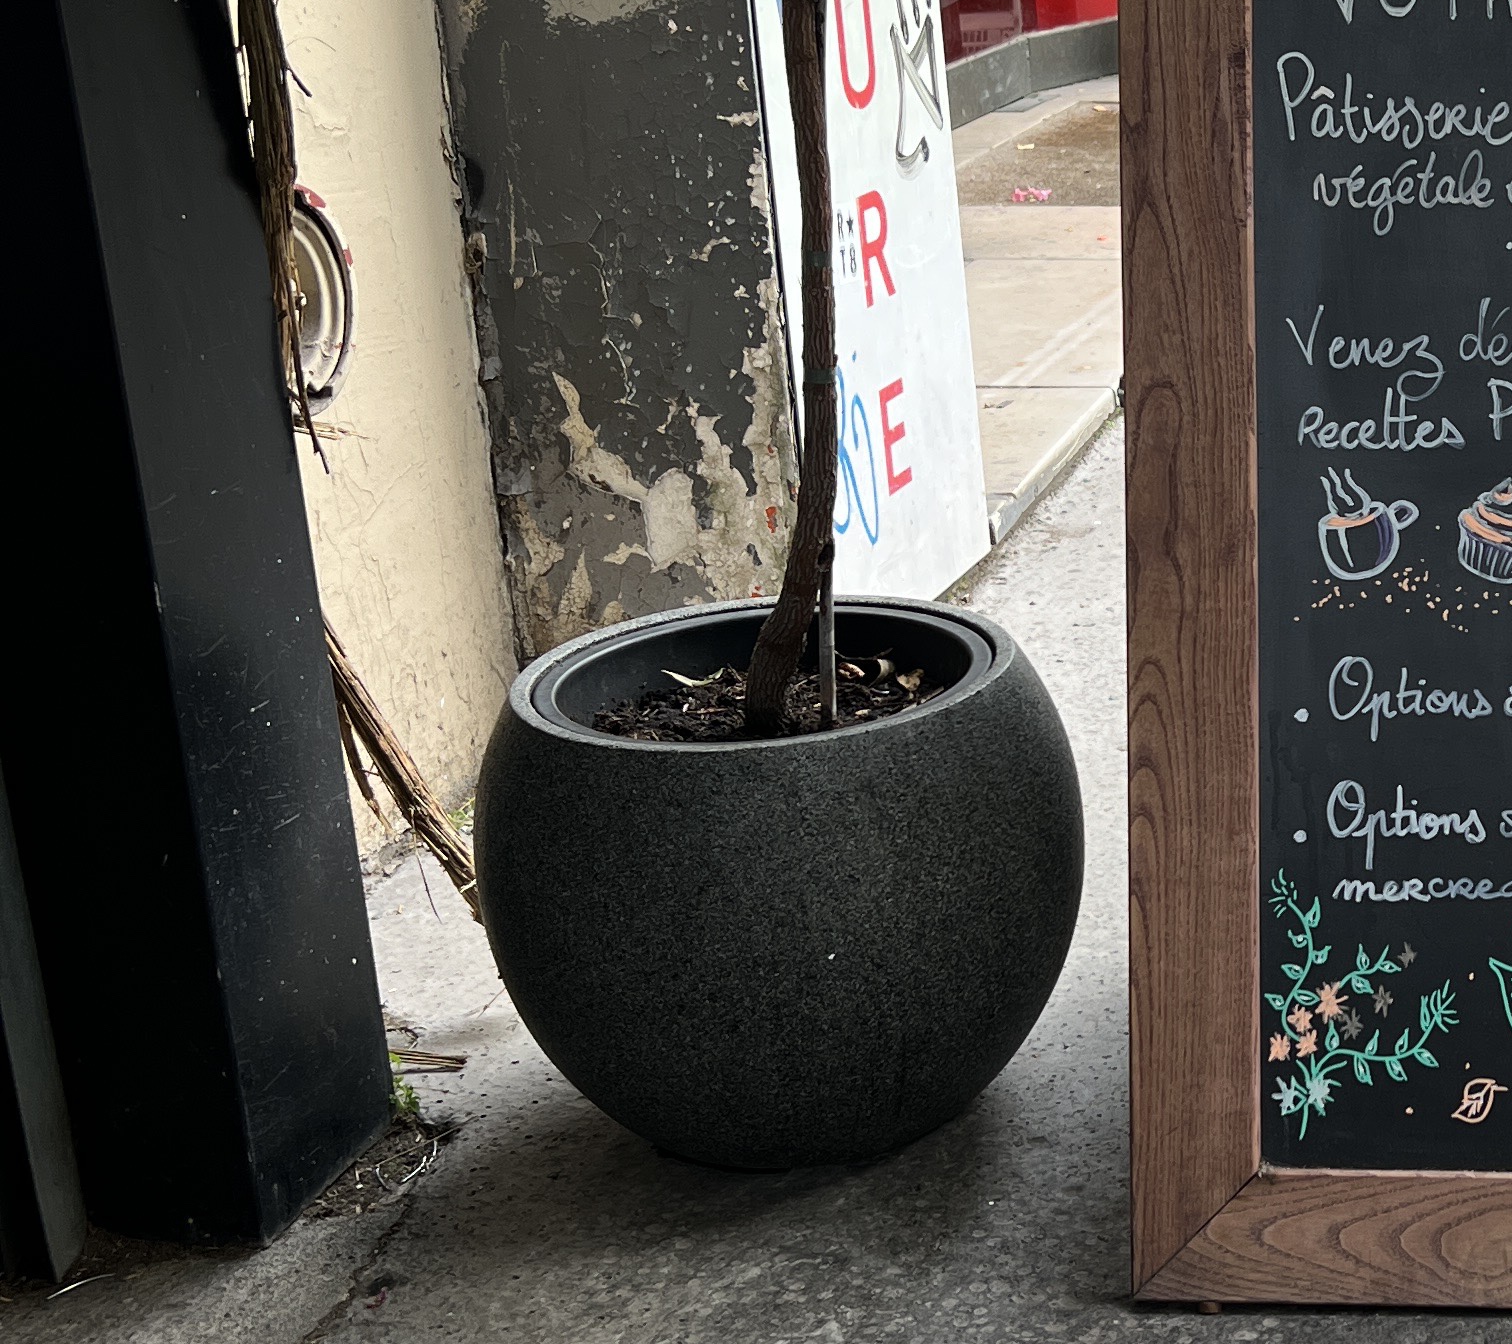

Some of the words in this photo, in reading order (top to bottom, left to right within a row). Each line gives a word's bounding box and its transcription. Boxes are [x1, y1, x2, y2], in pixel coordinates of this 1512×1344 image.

[1313, 151, 1494, 235] végétale
[1286, 305, 1445, 400] Venez
[1329, 656, 1492, 741] Options
[1327, 780, 1486, 870] Options
